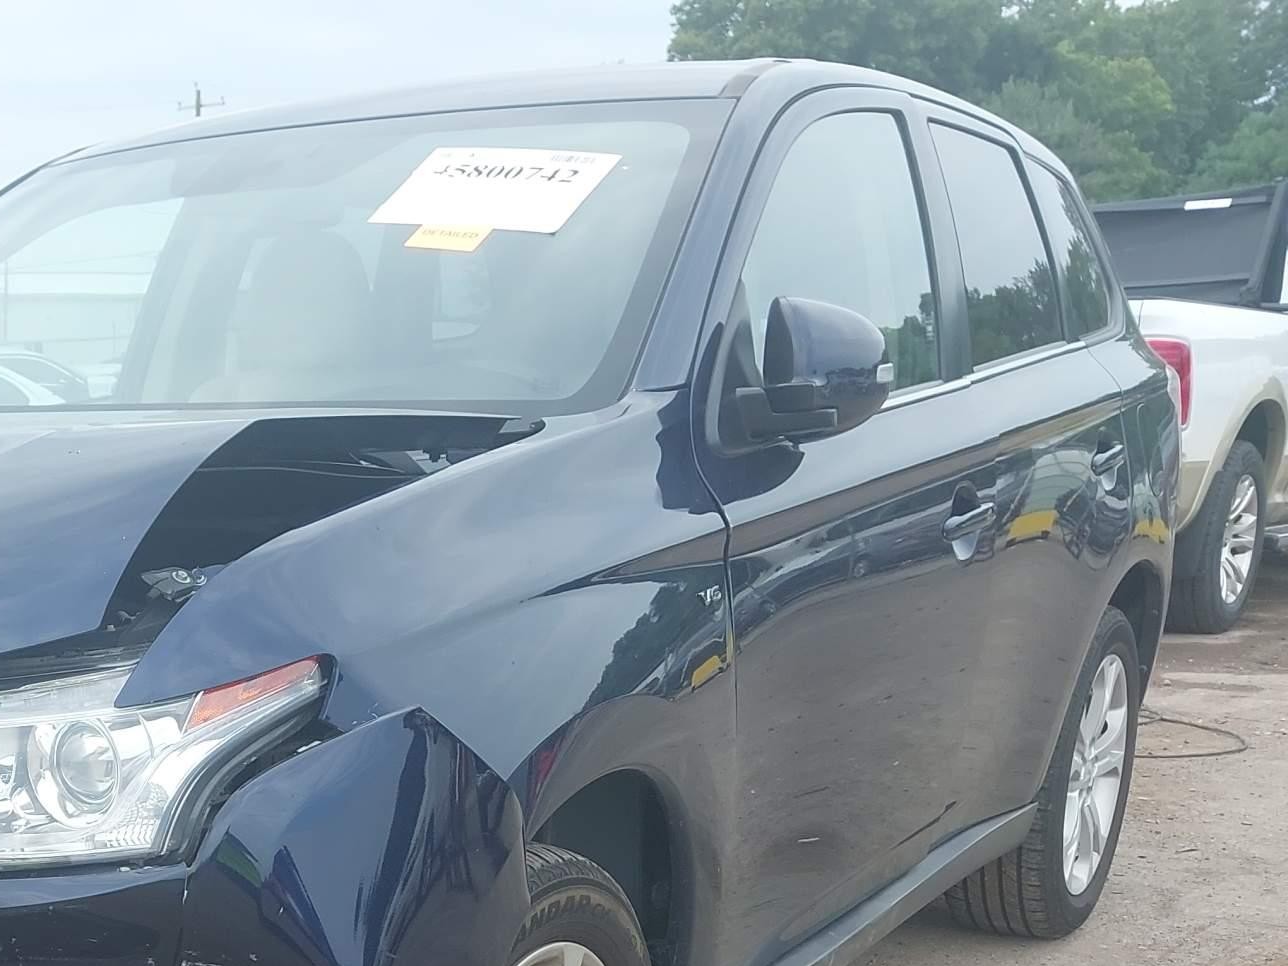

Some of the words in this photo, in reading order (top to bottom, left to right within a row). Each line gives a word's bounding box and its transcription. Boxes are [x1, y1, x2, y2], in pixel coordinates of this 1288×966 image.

[432, 162, 582, 184] 45800742
[696, 584, 723, 606] V6
[509, 892, 583, 946] ANDAR
